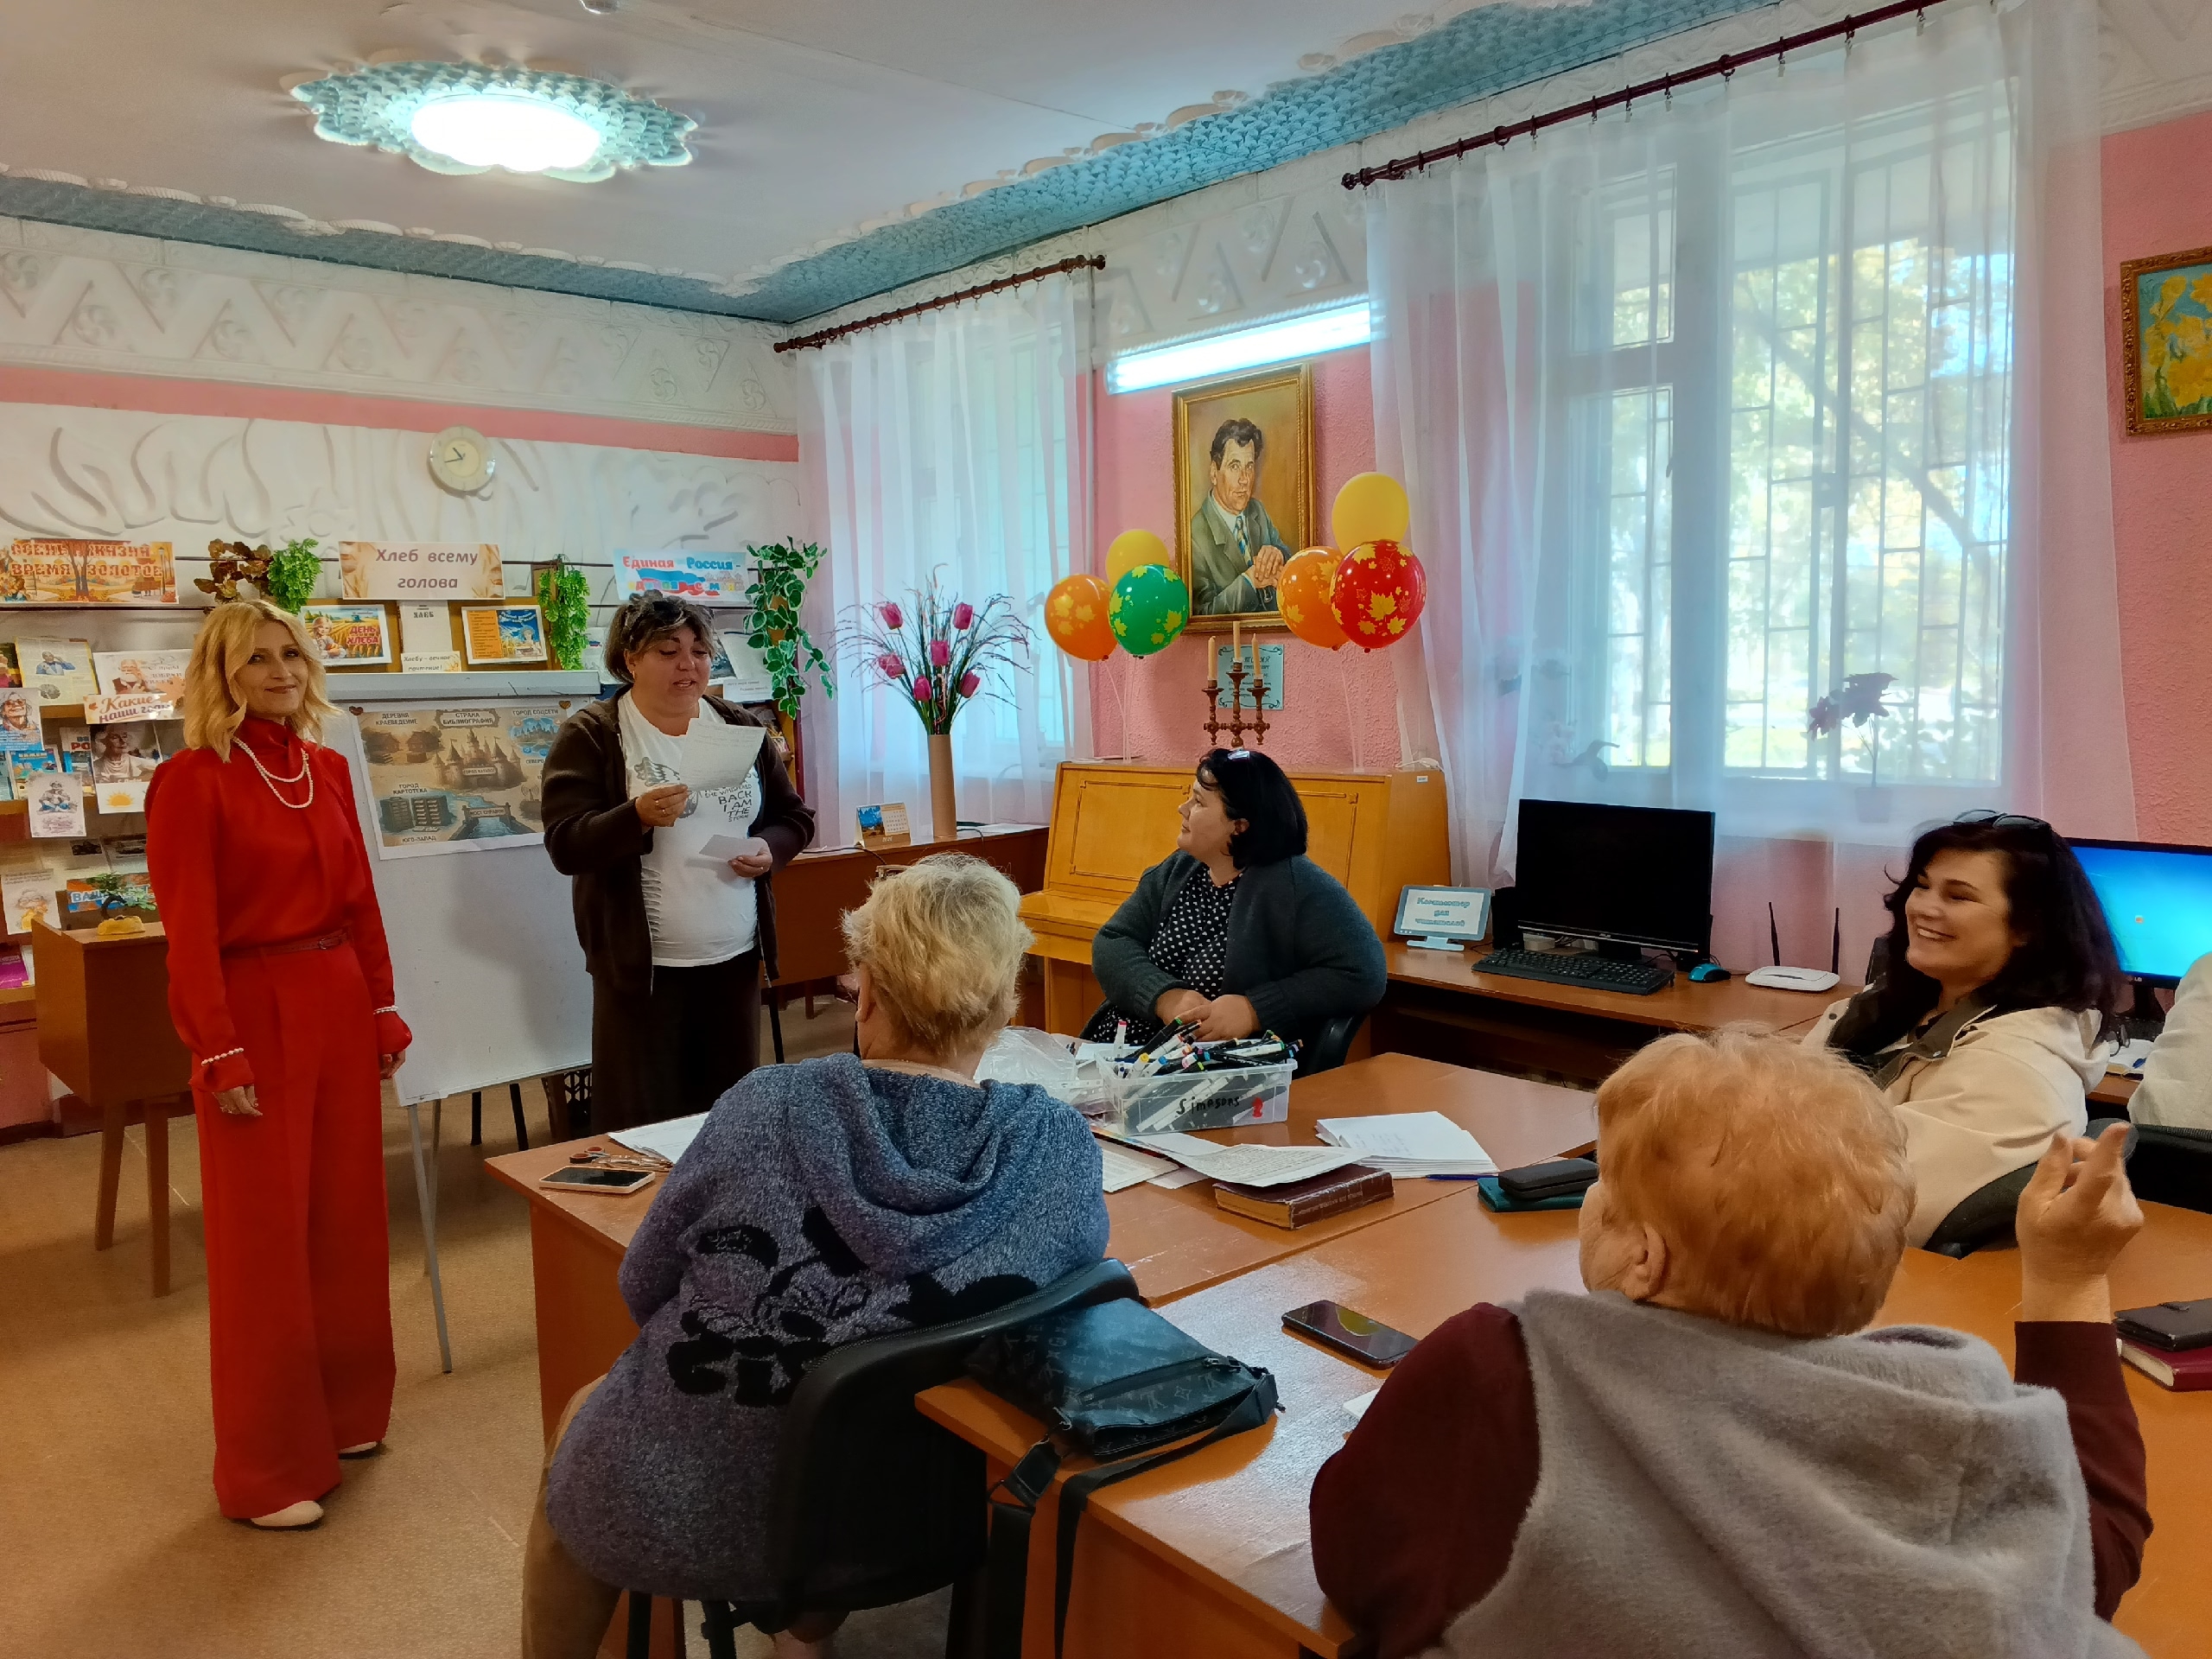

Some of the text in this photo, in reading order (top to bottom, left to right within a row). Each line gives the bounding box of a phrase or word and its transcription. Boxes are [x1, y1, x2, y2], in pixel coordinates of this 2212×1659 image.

[375, 549, 478, 566] Хлеб всему
[622, 556, 675, 569] Единая
[686, 556, 734, 570] Россия
[11, 563, 163, 576] ВРЕМЯ ЗОЛОТОЕ
[397, 577, 458, 588] голова
[346, 636, 378, 645] ХЛЕБА
[99, 695, 154, 715] Какие
[99, 708, 138, 723] наши
[718, 791, 753, 804] BACK
[723, 799, 753, 812] I AM
[727, 806, 751, 818] THE
